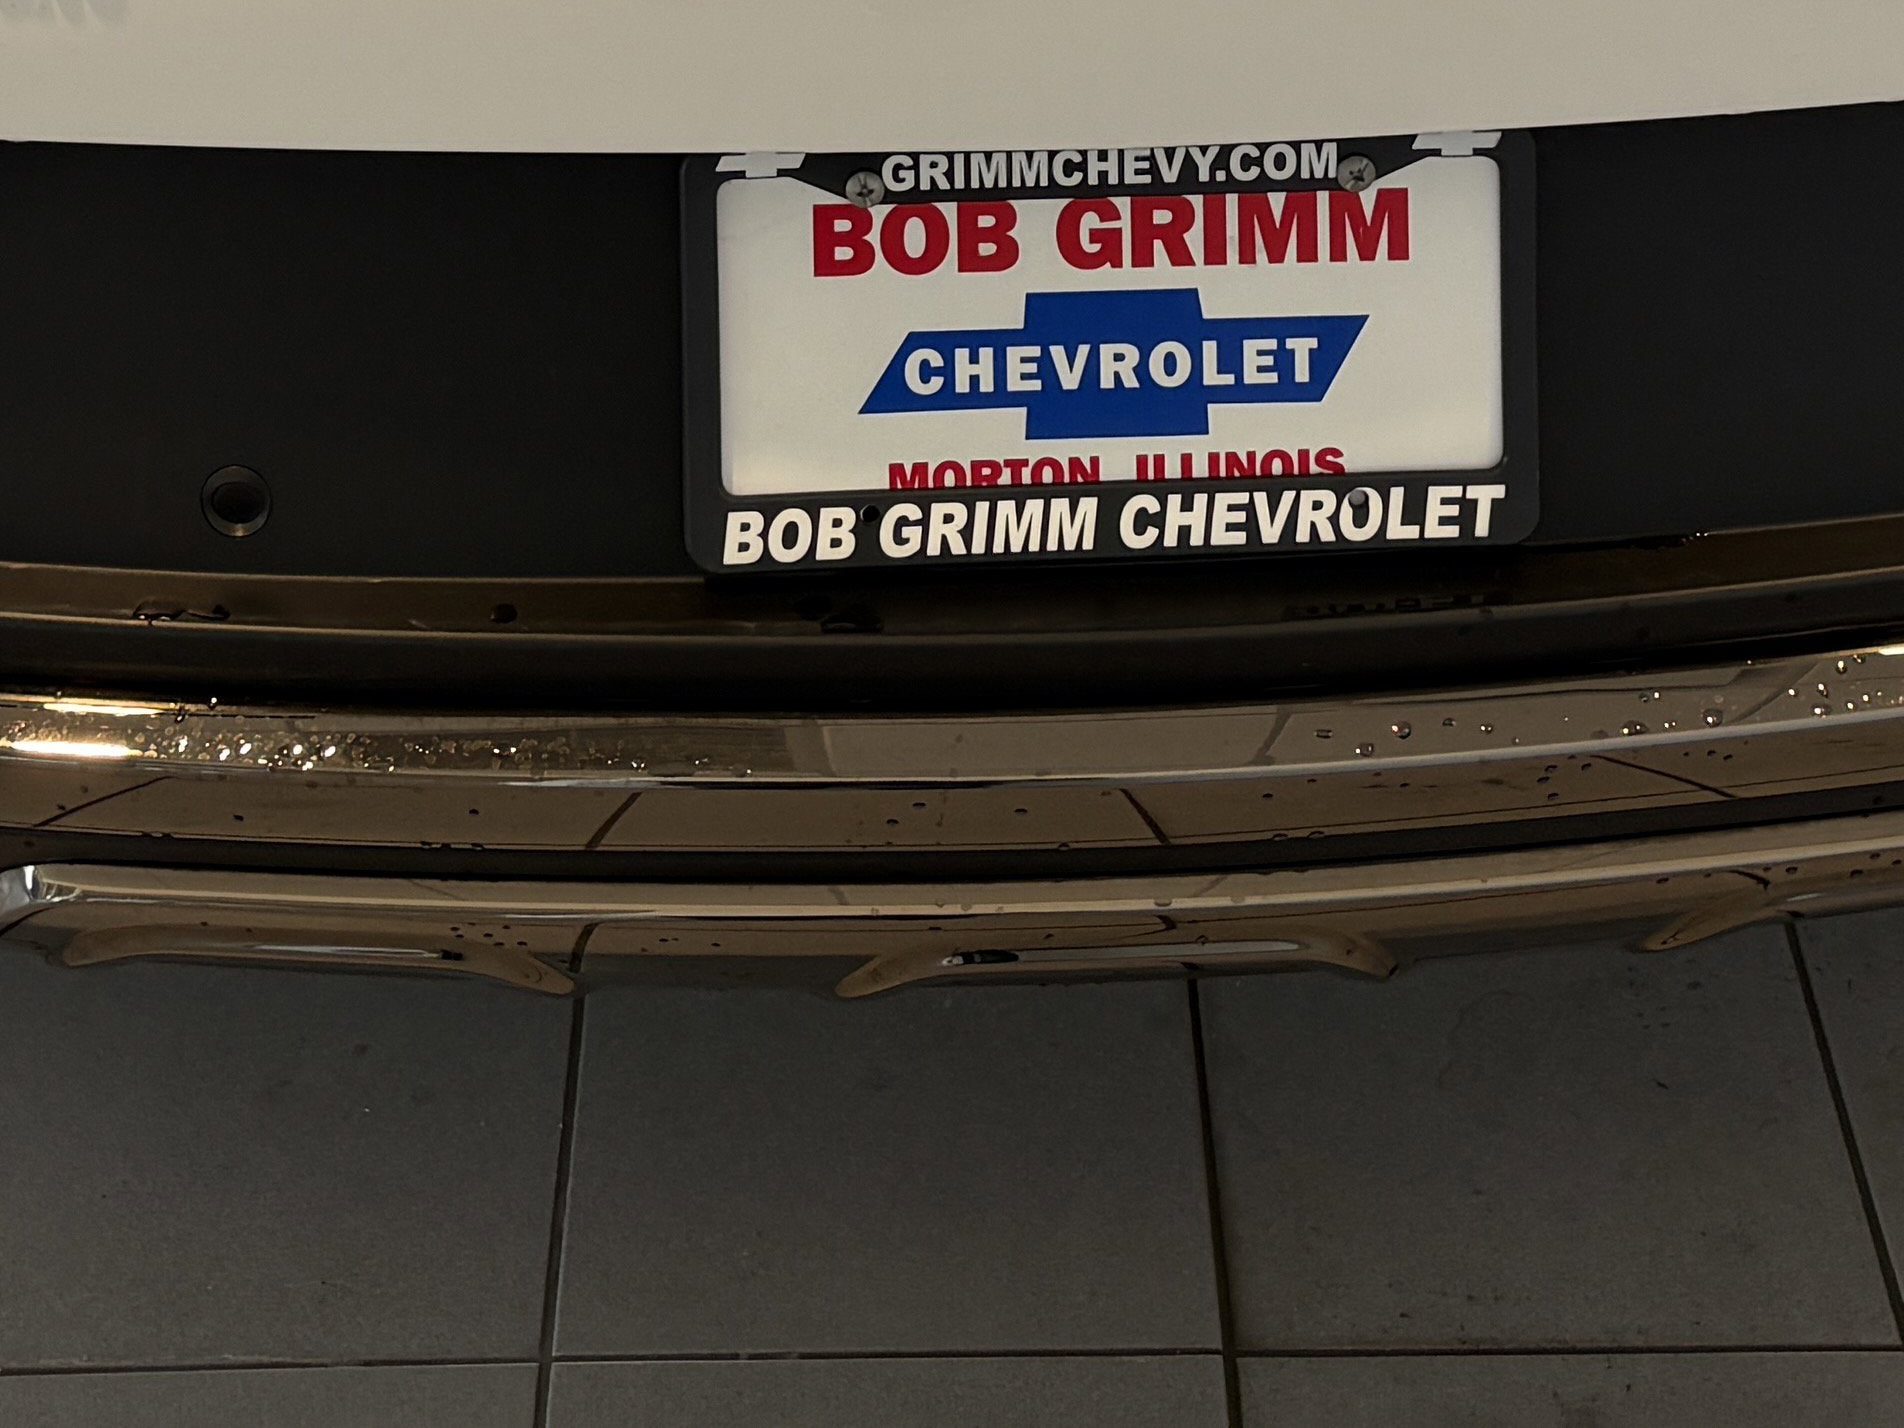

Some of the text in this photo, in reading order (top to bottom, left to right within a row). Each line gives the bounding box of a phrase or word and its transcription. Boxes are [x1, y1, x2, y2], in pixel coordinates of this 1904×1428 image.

[880, 141, 1340, 193] GRIMMCHEVY.COM
[813, 188, 1410, 277] BOB GRIMM
[904, 337, 1319, 396] CHEVROLET
[723, 484, 1507, 565] BOB GRIMM CHEVROLET
